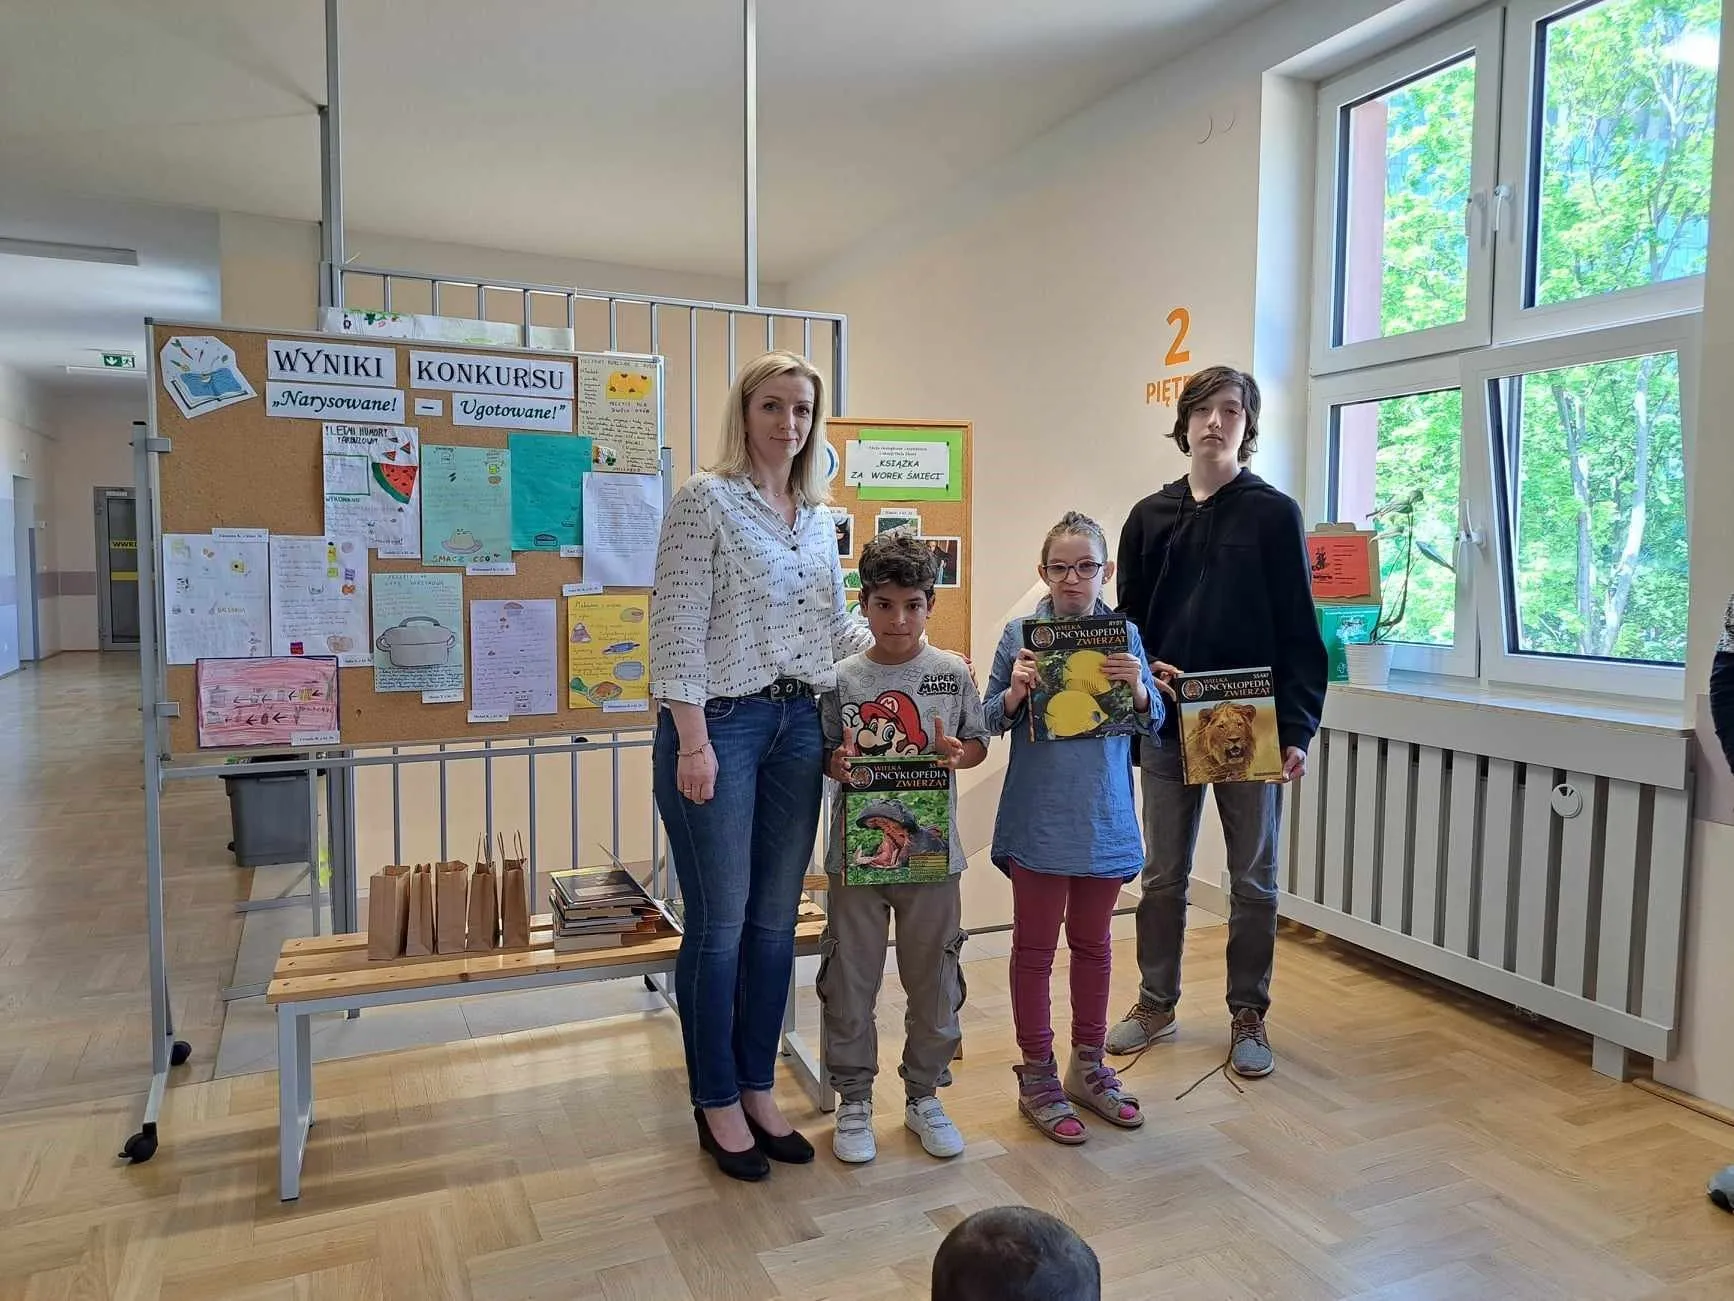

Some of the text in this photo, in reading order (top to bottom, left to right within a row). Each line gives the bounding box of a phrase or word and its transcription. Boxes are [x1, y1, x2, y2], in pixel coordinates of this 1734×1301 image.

[1164, 307, 1190, 366] 2
[274, 347, 565, 390] WYNIKI KONKURSU
[850, 471, 864, 479] ZA
[871, 471, 903, 480] WOREK
[1056, 628, 1126, 639] ENCYKLOPEDIA
[1076, 635, 1127, 646] ZWIERZĄT
[923, 674, 955, 682] SUPER
[917, 682, 959, 695] MARIO
[1204, 679, 1271, 691] ENCYKLOPEDIA
[1224, 687, 1270, 697] ZWIERZĄT
[874, 770, 948, 780] ENCYKLOPEDIA
[895, 779, 947, 788] ZWIERZĄT
